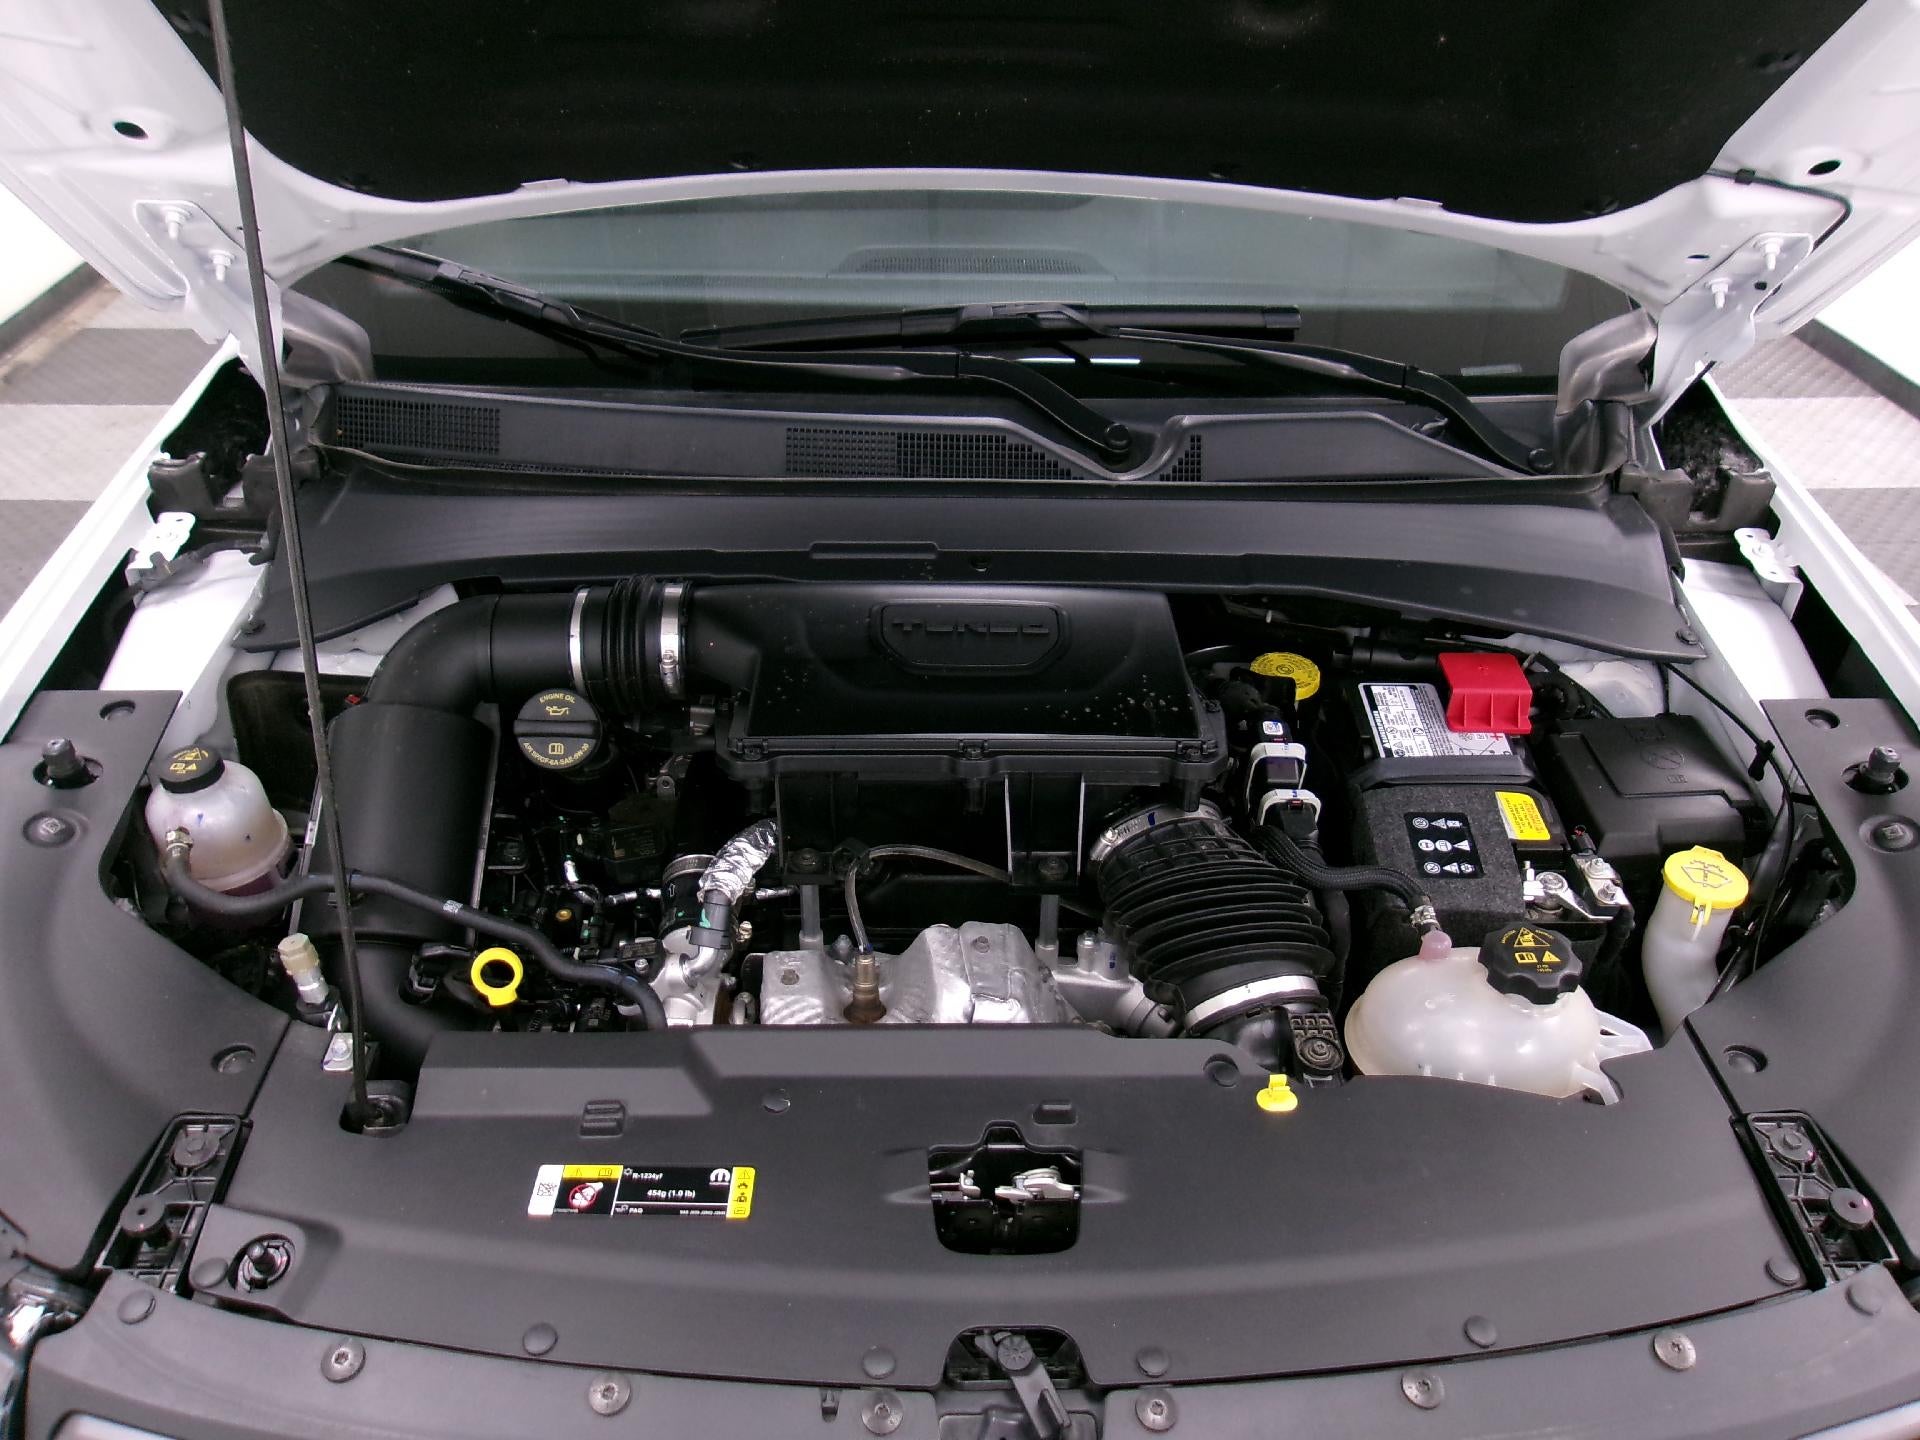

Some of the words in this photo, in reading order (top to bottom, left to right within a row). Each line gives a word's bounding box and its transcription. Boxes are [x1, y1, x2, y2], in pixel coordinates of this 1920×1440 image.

[539, 692, 565, 703] ENGINE
[565, 694, 576, 704] OIL
[632, 1172, 663, 1180] R-1234yf
[647, 1189, 667, 1198] 454g
[668, 1189, 684, 1198] (1.0
[684, 1189, 696, 1198] lb)
